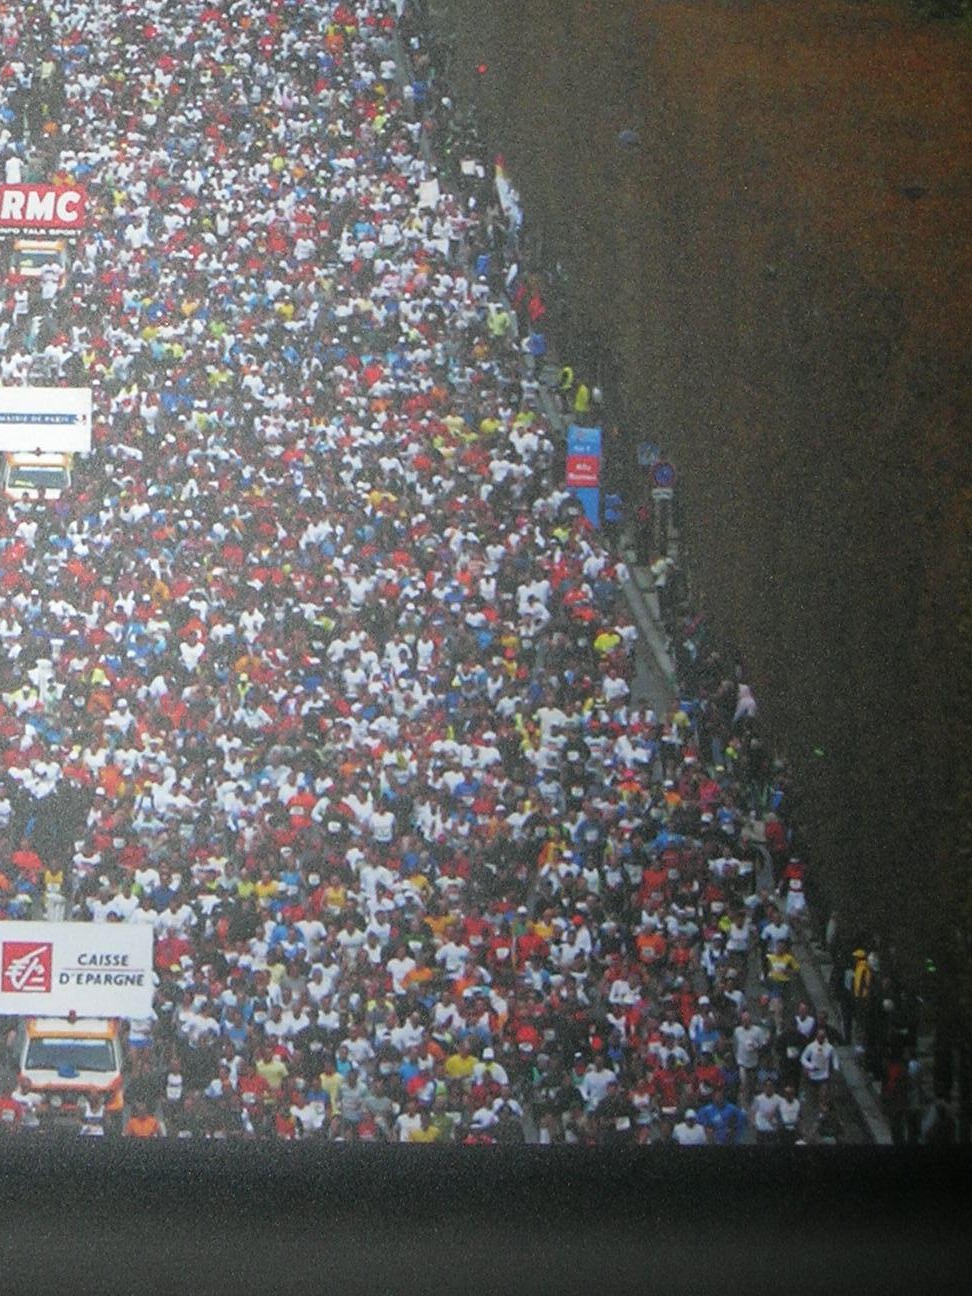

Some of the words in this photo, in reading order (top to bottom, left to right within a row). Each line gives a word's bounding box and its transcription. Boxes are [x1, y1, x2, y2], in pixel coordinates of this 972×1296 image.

[0, 190, 81, 222] RMC
[77, 954, 129, 967] CAISSE
[59, 972, 144, 986] D'EPARGNE
